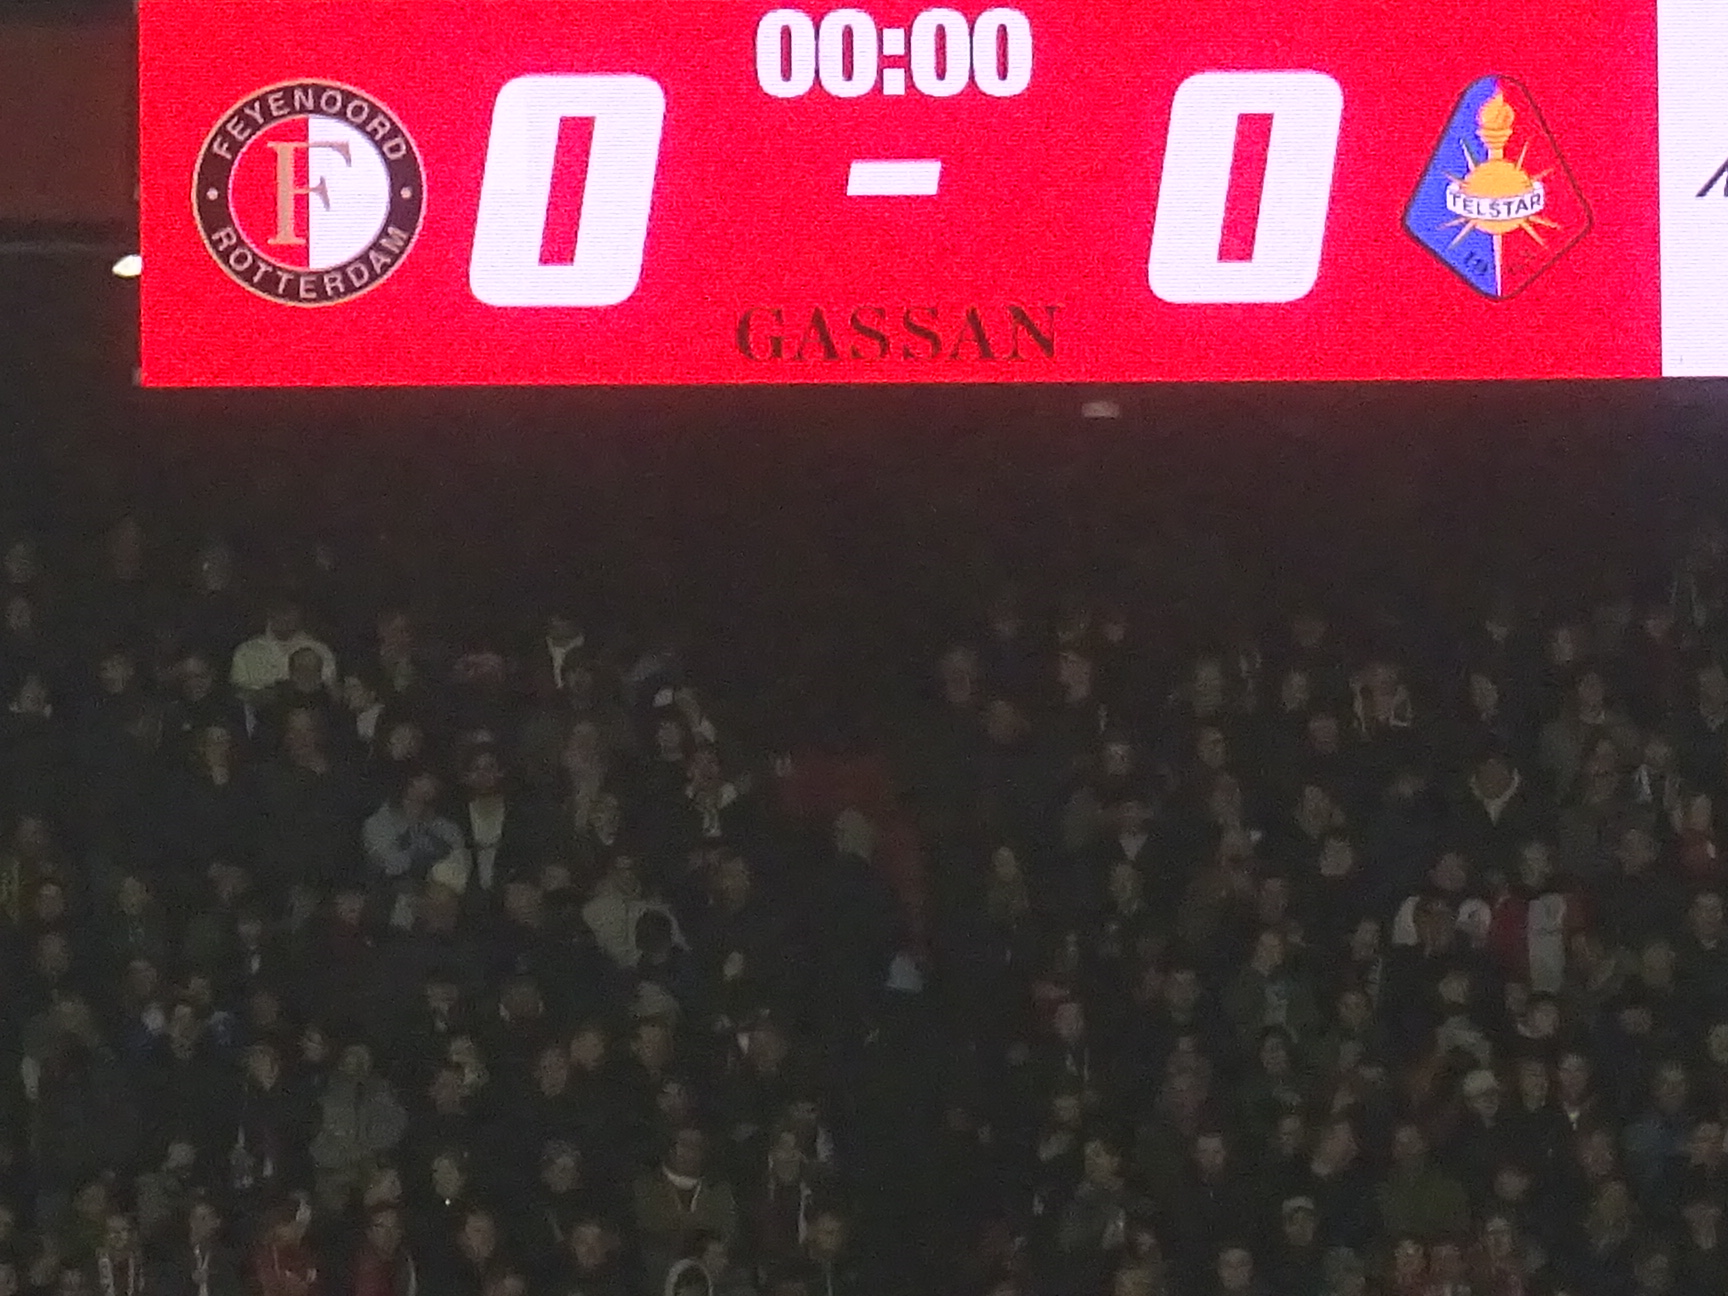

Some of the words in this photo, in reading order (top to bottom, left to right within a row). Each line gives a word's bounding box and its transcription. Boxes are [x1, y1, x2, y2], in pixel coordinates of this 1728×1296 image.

[755, 7, 1033, 98] 00:00
[212, 87, 408, 160] FEYENOORD
[267, 141, 352, 245] F
[469, 72, 667, 308] 0
[1147, 68, 1344, 304] 0
[1448, 192, 1542, 219] TELSTAR
[211, 226, 410, 299] ROTTERDAM
[735, 306, 1062, 362] GASSAN
